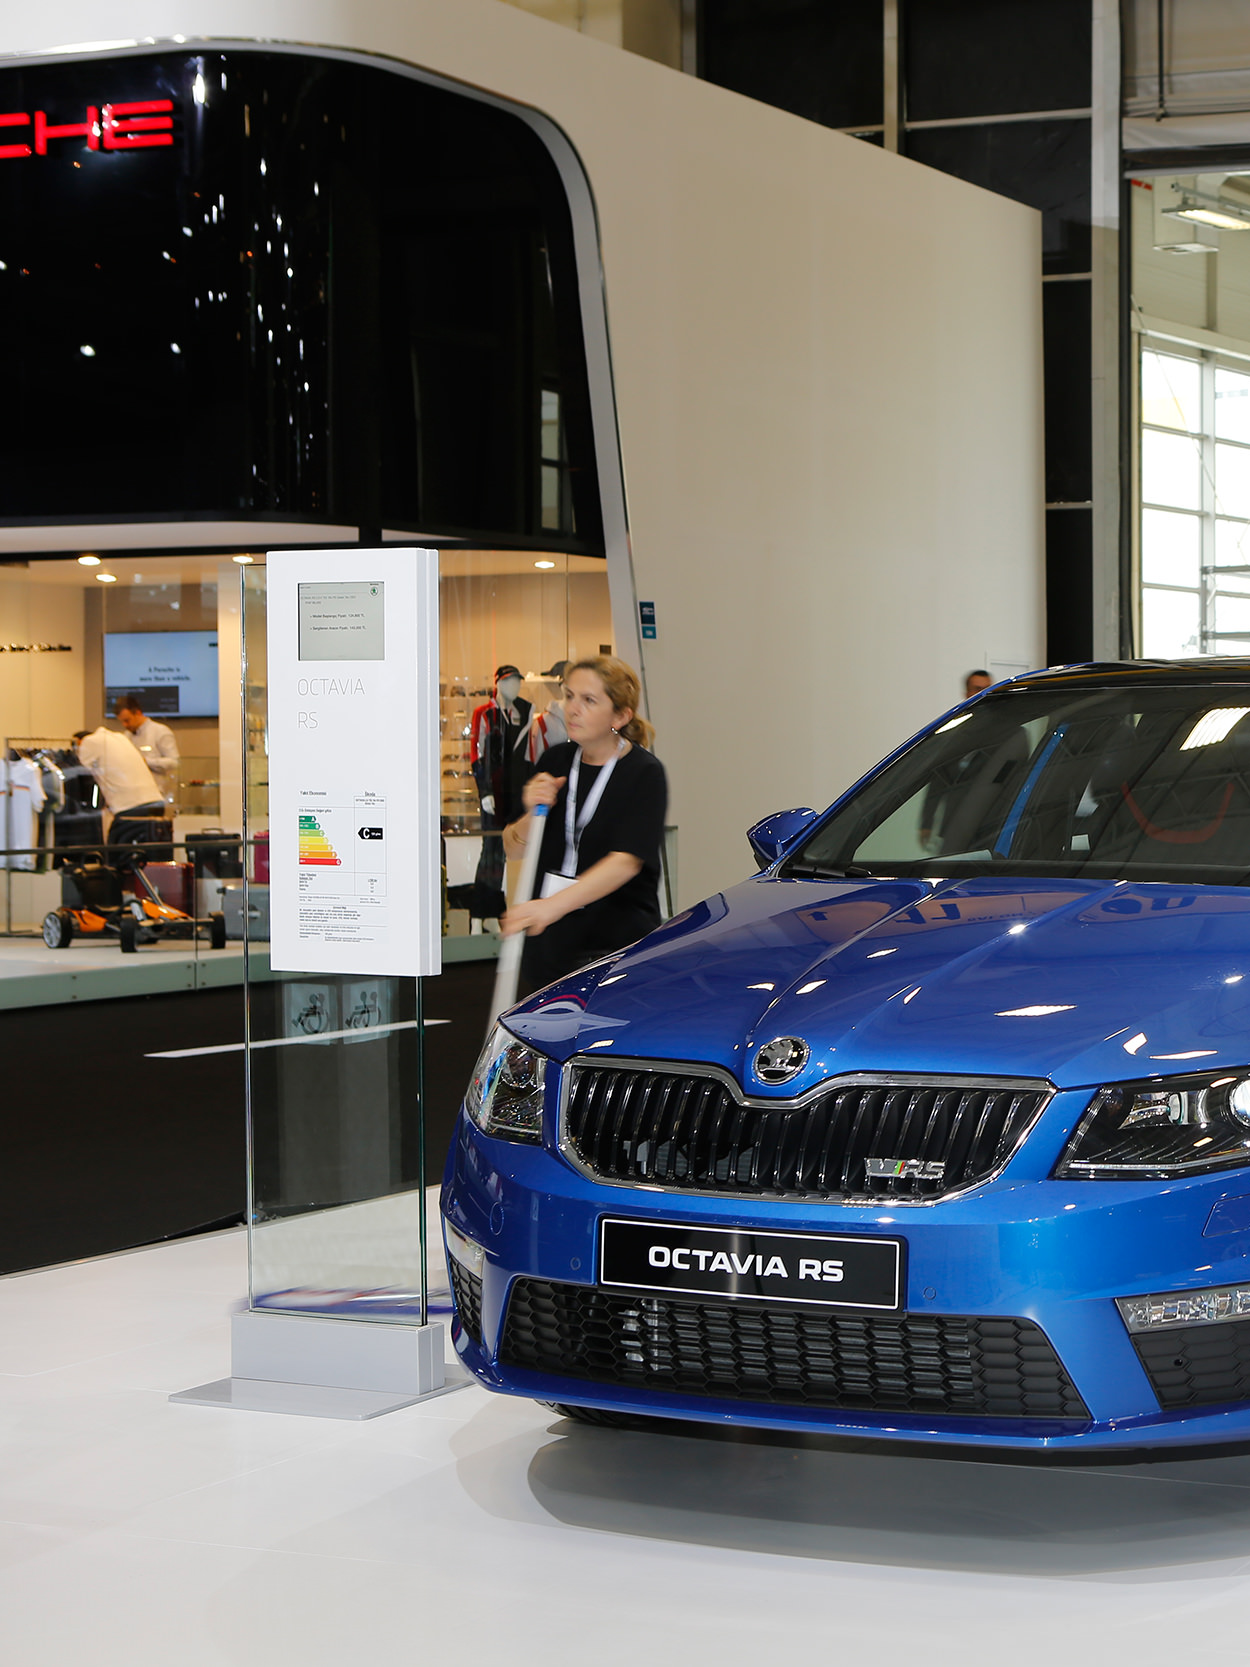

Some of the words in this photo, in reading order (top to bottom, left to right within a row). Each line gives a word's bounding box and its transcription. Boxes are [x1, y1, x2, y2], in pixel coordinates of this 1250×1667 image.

[297, 678, 366, 696] OCTAVIA
[297, 711, 319, 729] RS
[363, 828, 370, 839] C
[648, 1245, 789, 1279] OCTAVIA
[798, 1258, 844, 1283] RS
